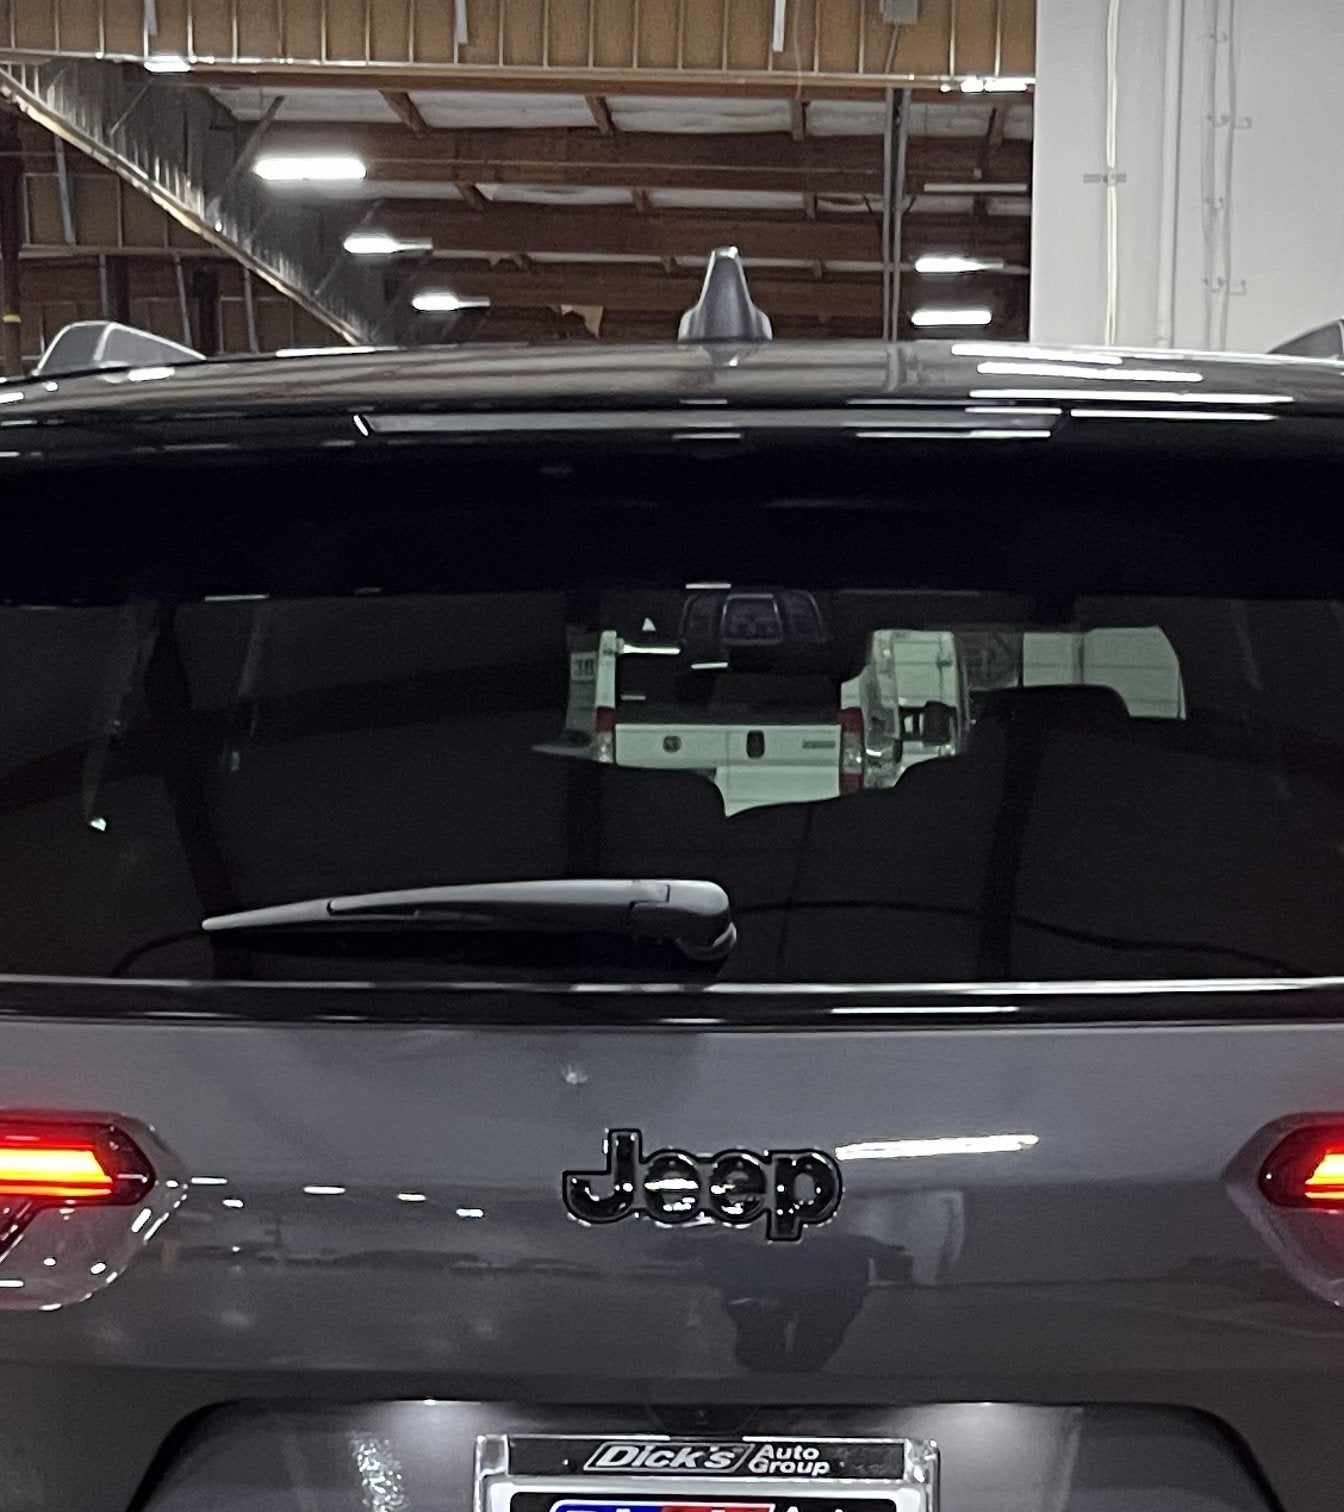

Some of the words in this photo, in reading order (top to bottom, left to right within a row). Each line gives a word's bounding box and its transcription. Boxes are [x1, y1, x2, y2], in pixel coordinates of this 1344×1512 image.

[561, 1127, 844, 1242] Jeep
[594, 1442, 739, 1470] Dick's
[755, 1443, 821, 1461] Auto
[748, 1459, 831, 1478] Group
